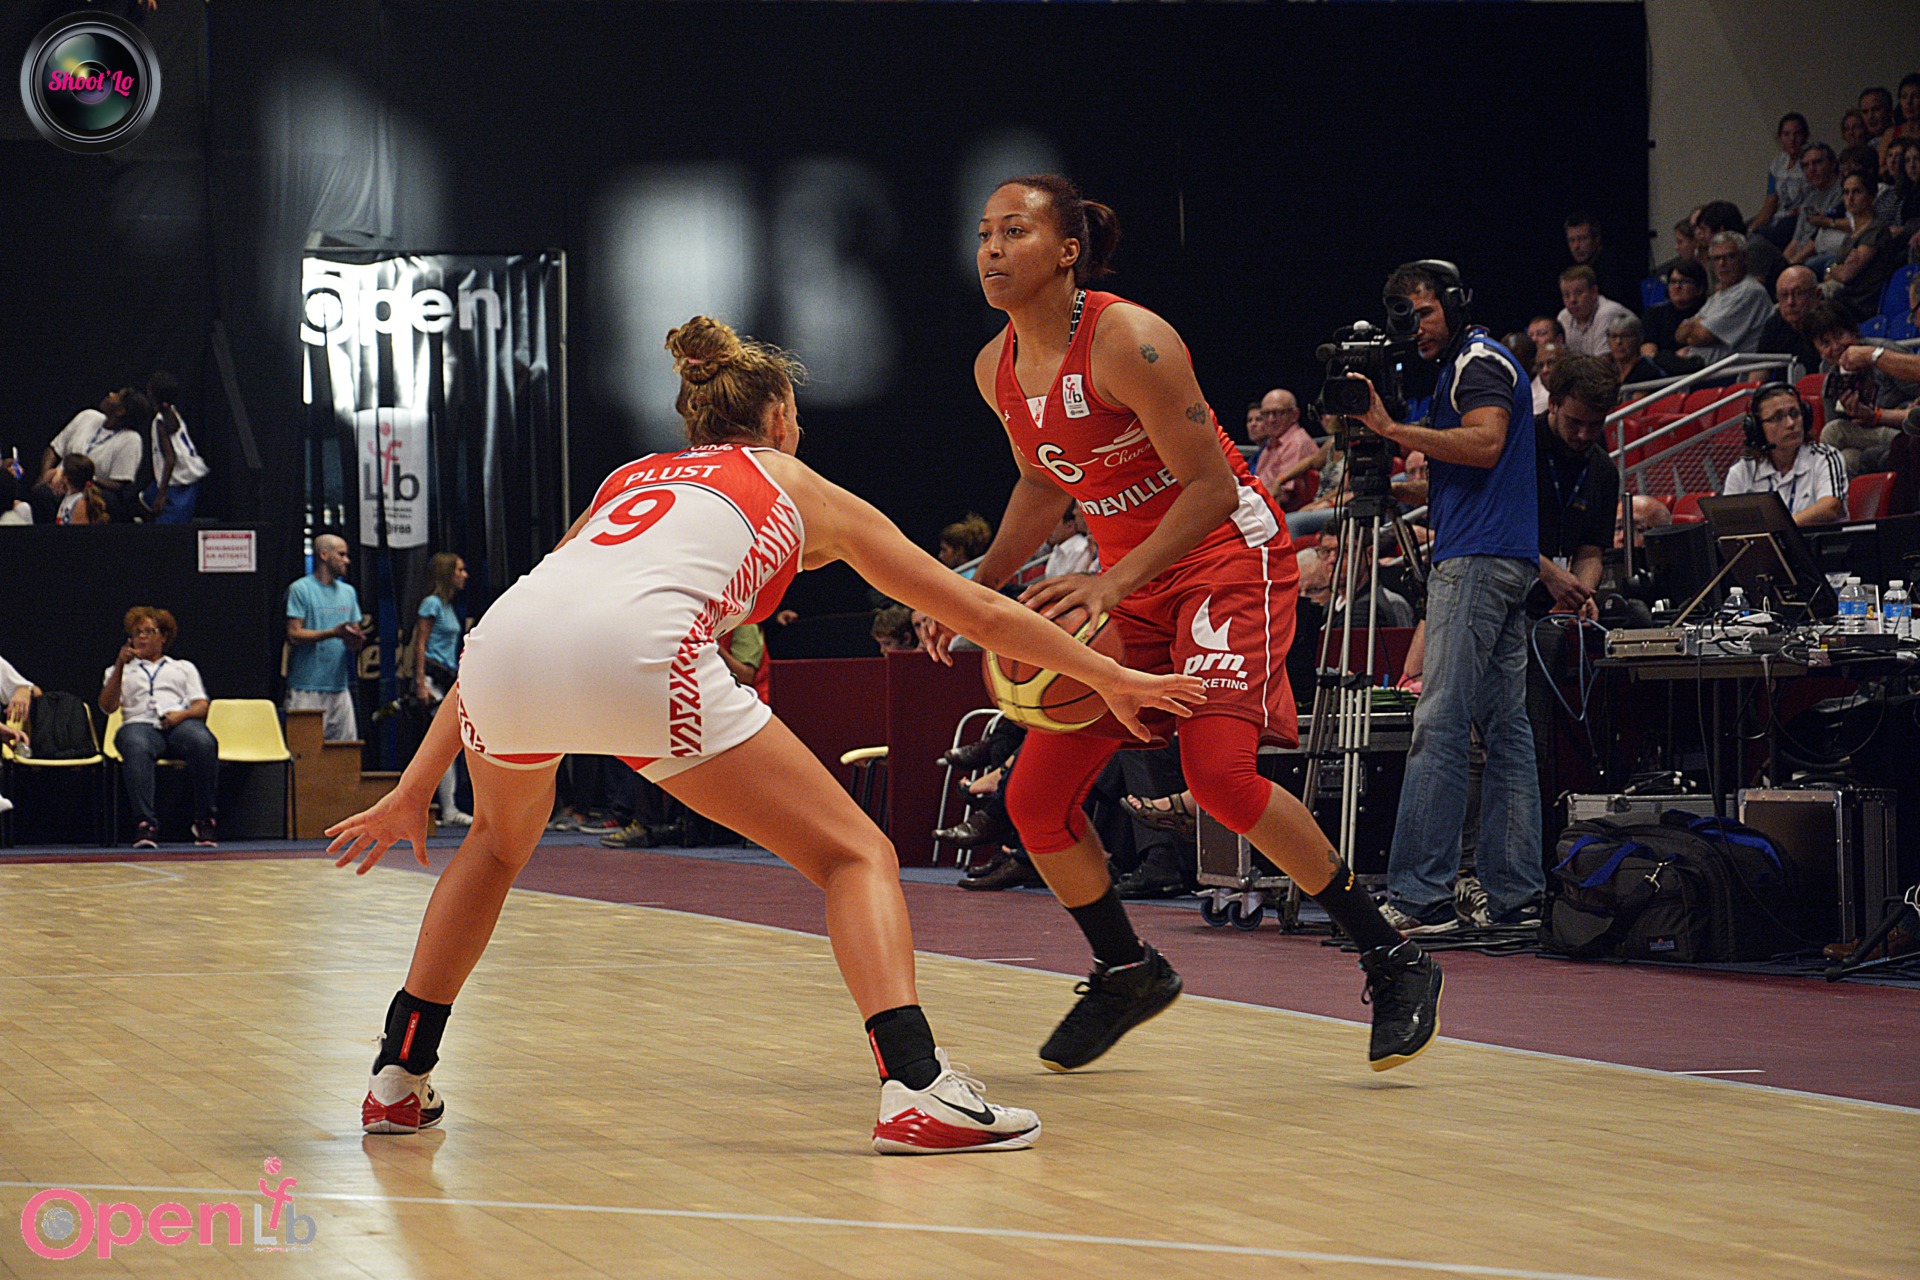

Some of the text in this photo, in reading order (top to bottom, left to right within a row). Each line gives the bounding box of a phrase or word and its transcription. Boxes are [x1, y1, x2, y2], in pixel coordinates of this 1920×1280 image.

[623, 465, 722, 487] PLUST
[1037, 442, 1085, 484] 6
[590, 488, 677, 547] 9
[1201, 679, 1248, 691] KETING
